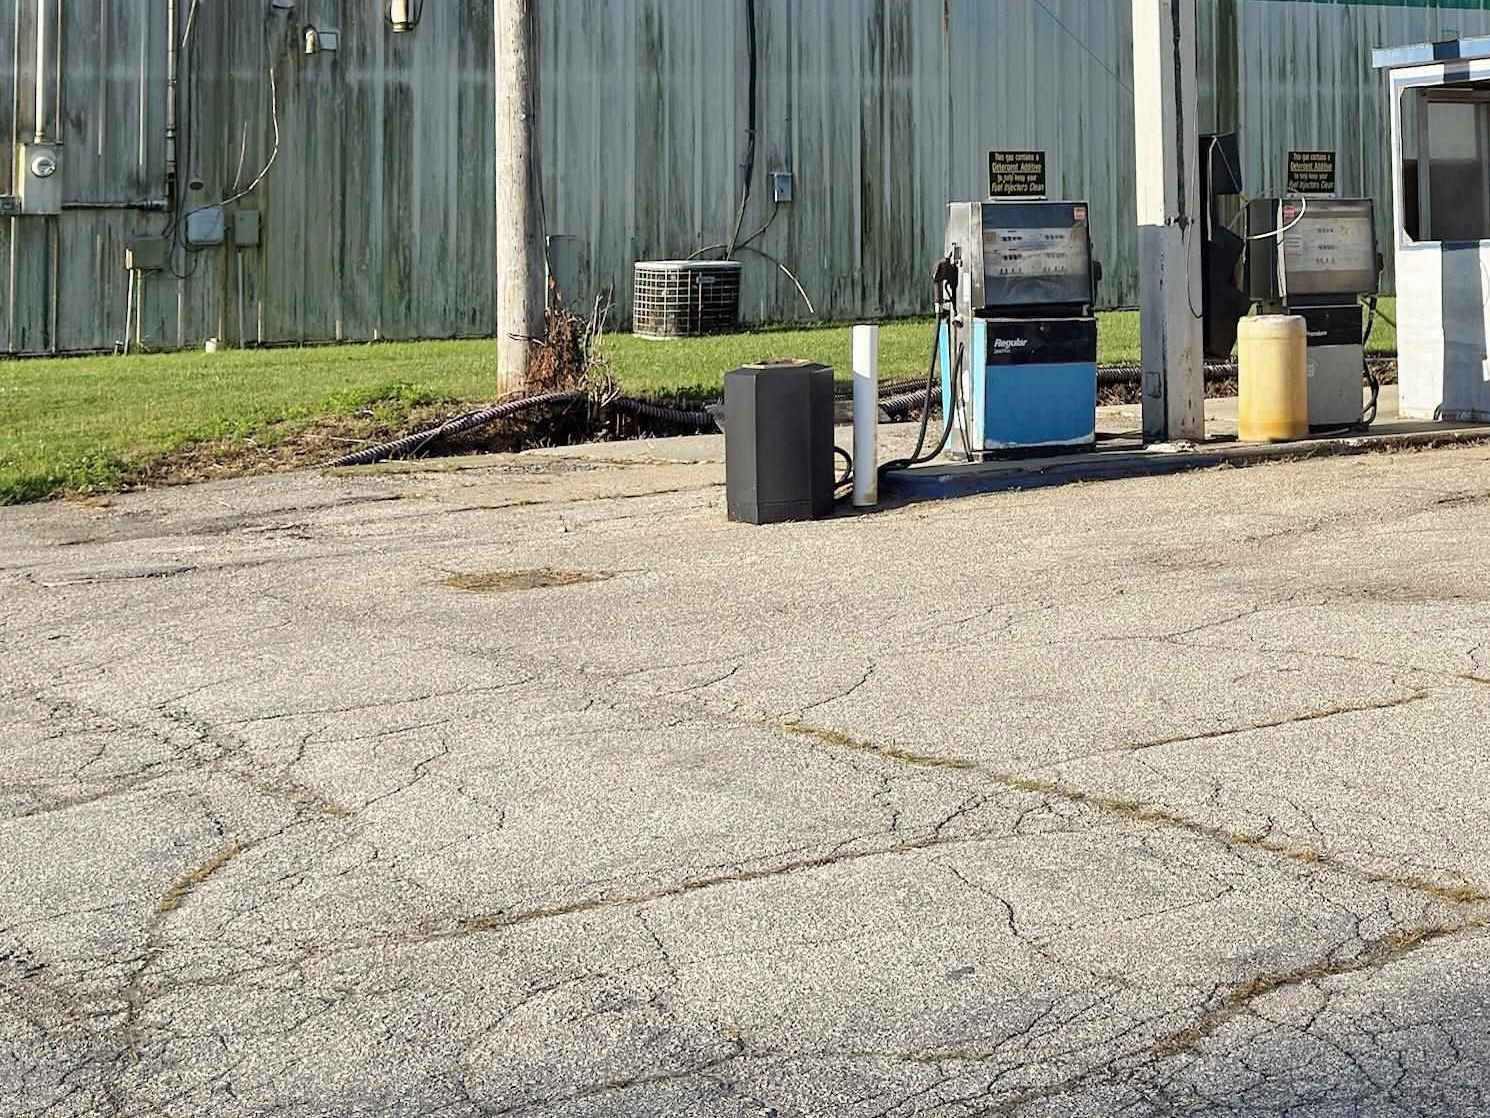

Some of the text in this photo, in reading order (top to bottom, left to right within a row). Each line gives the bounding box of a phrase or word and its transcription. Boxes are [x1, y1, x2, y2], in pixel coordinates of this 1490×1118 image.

[992, 162, 1041, 172] Detergent Additive
[992, 183, 1045, 194] Fuel Injectors Clean
[994, 338, 1028, 349] Regular
